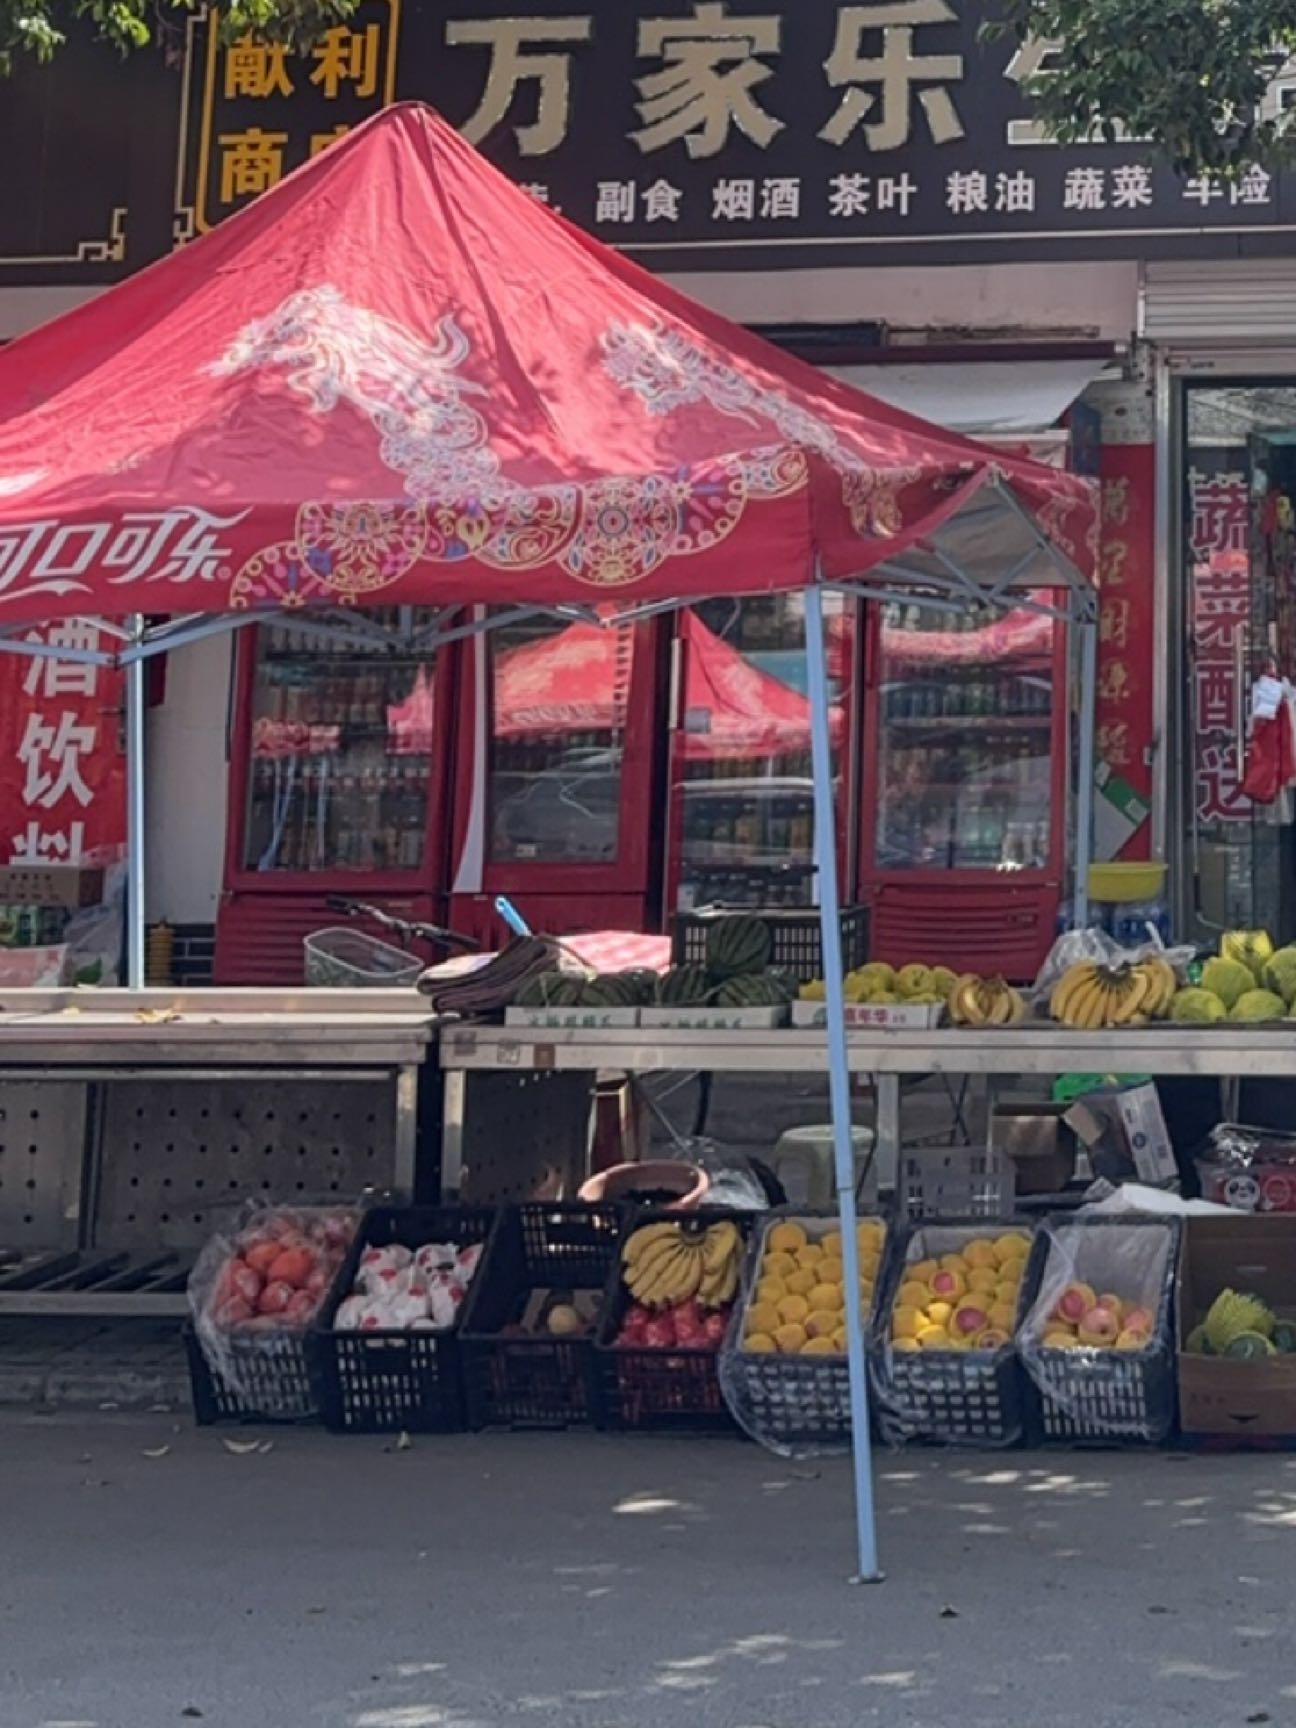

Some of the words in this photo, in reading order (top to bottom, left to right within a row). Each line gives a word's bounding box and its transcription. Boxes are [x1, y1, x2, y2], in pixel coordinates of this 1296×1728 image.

[596, 179, 683, 223] 副食
[712, 178, 800, 220] 烟酒
[829, 174, 917, 216] 茶叶
[947, 170, 1035, 213] 粮油
[1063, 165, 1153, 210] 蔬菜
[0, 505, 253, 602] 可口可乐
